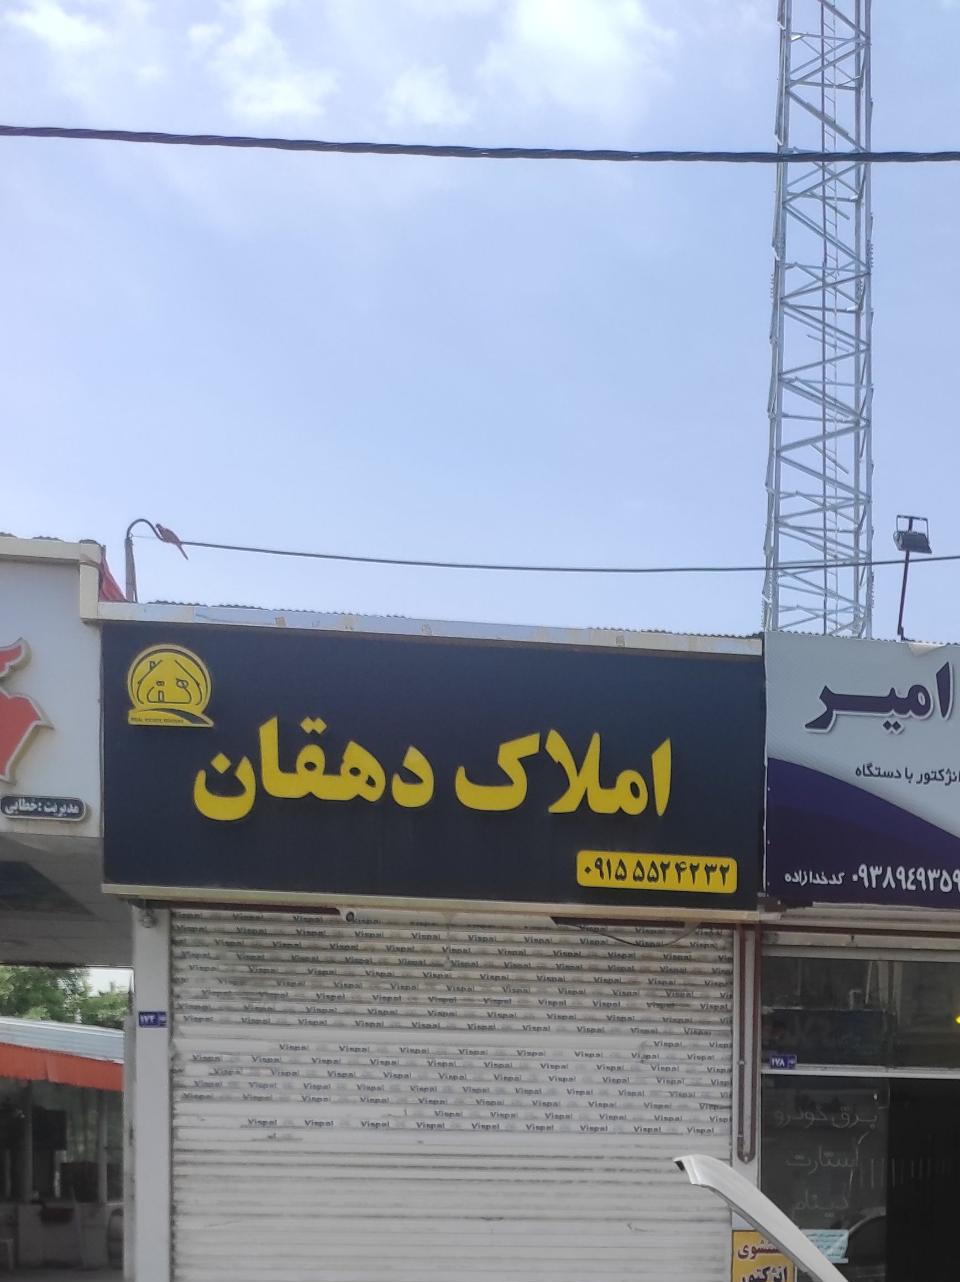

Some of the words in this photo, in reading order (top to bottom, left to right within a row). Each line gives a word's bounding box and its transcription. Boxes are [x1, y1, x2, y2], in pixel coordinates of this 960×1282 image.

[804, 661, 954, 734] امیر
[193, 715, 434, 821] دهقان
[455, 729, 672, 816] املاک
[855, 763, 902, 779] دستگاه
[904, 767, 913, 784] با
[916, 768, 960, 785] انژکتور
